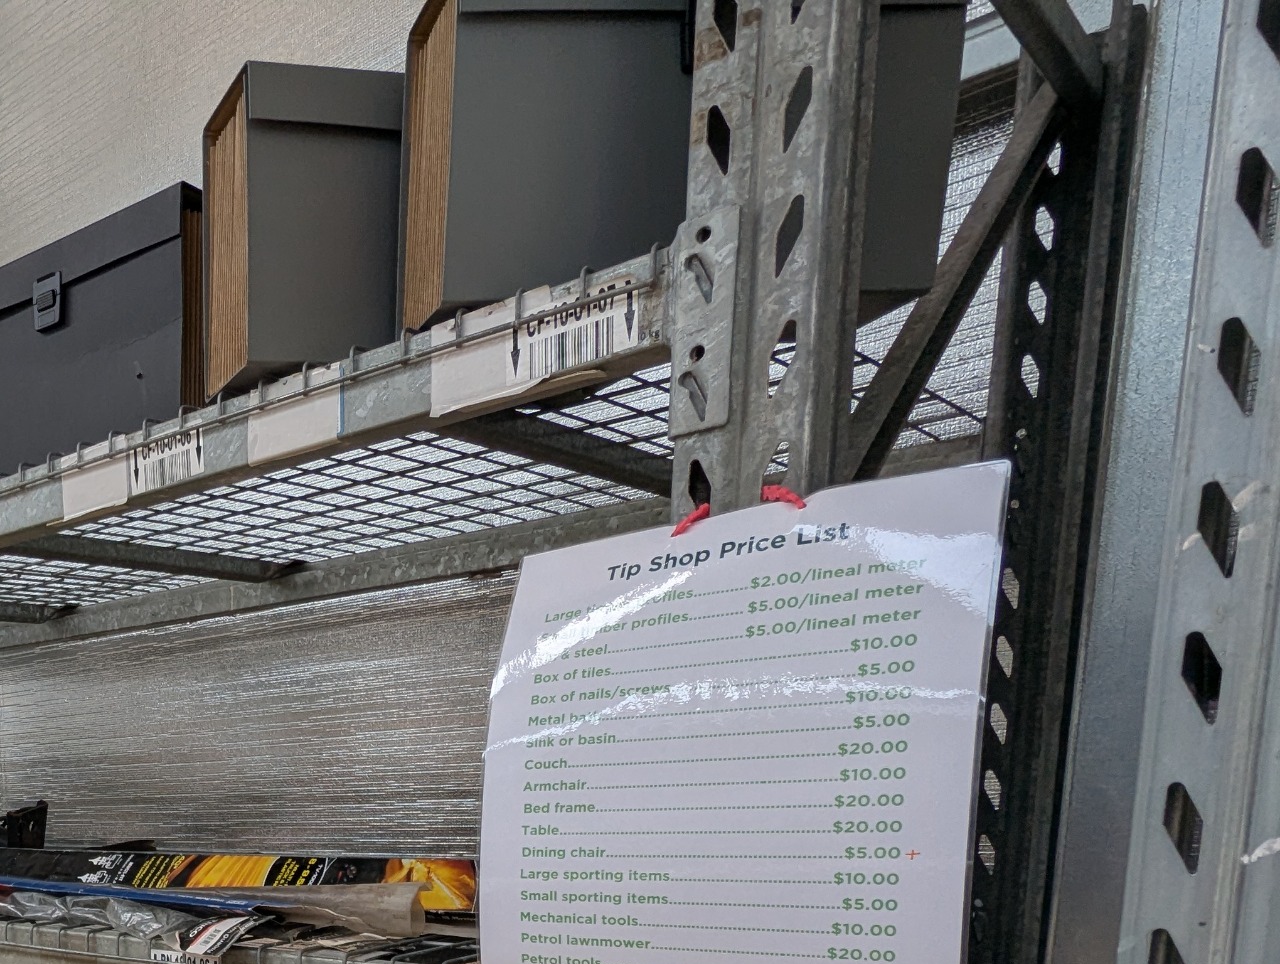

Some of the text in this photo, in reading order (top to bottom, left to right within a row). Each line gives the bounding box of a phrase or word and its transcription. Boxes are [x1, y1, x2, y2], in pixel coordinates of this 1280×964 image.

[607, 522, 850, 581] Tip Shop Price List
[544, 608, 582, 623] Large
[641, 588, 694, 607] ofiles
[750, 563, 862, 590] $2.00/lineal
[631, 612, 689, 631] profiles
[747, 588, 859, 615] $5.00/lineal
[865, 582, 924, 599] meter
[561, 609, 921, 660] & steel $5.00/lineal meter
[533, 633, 918, 684] Box of tiles $10.00
[530, 660, 915, 705] Box of nails/screws $5.00
[528, 713, 565, 727] Metal
[846, 686, 912, 704] $10.00
[526, 713, 910, 749] Sink or basin $5.00
[524, 740, 908, 770] Couch $20.00
[523, 767, 906, 792] Armchair $10.00
[523, 793, 904, 814] Bed frame $20.00
[521, 819, 902, 836] Table $20.00
[522, 846, 901, 860] Dining chair $5.00
[520, 869, 899, 886] Large sporting items $10.00
[520, 890, 898, 911] Small sporting items $5.00
[520, 911, 897, 937] Mechanical tools $10.00
[521, 933, 895, 962] Petrol lawnmower $20.00
